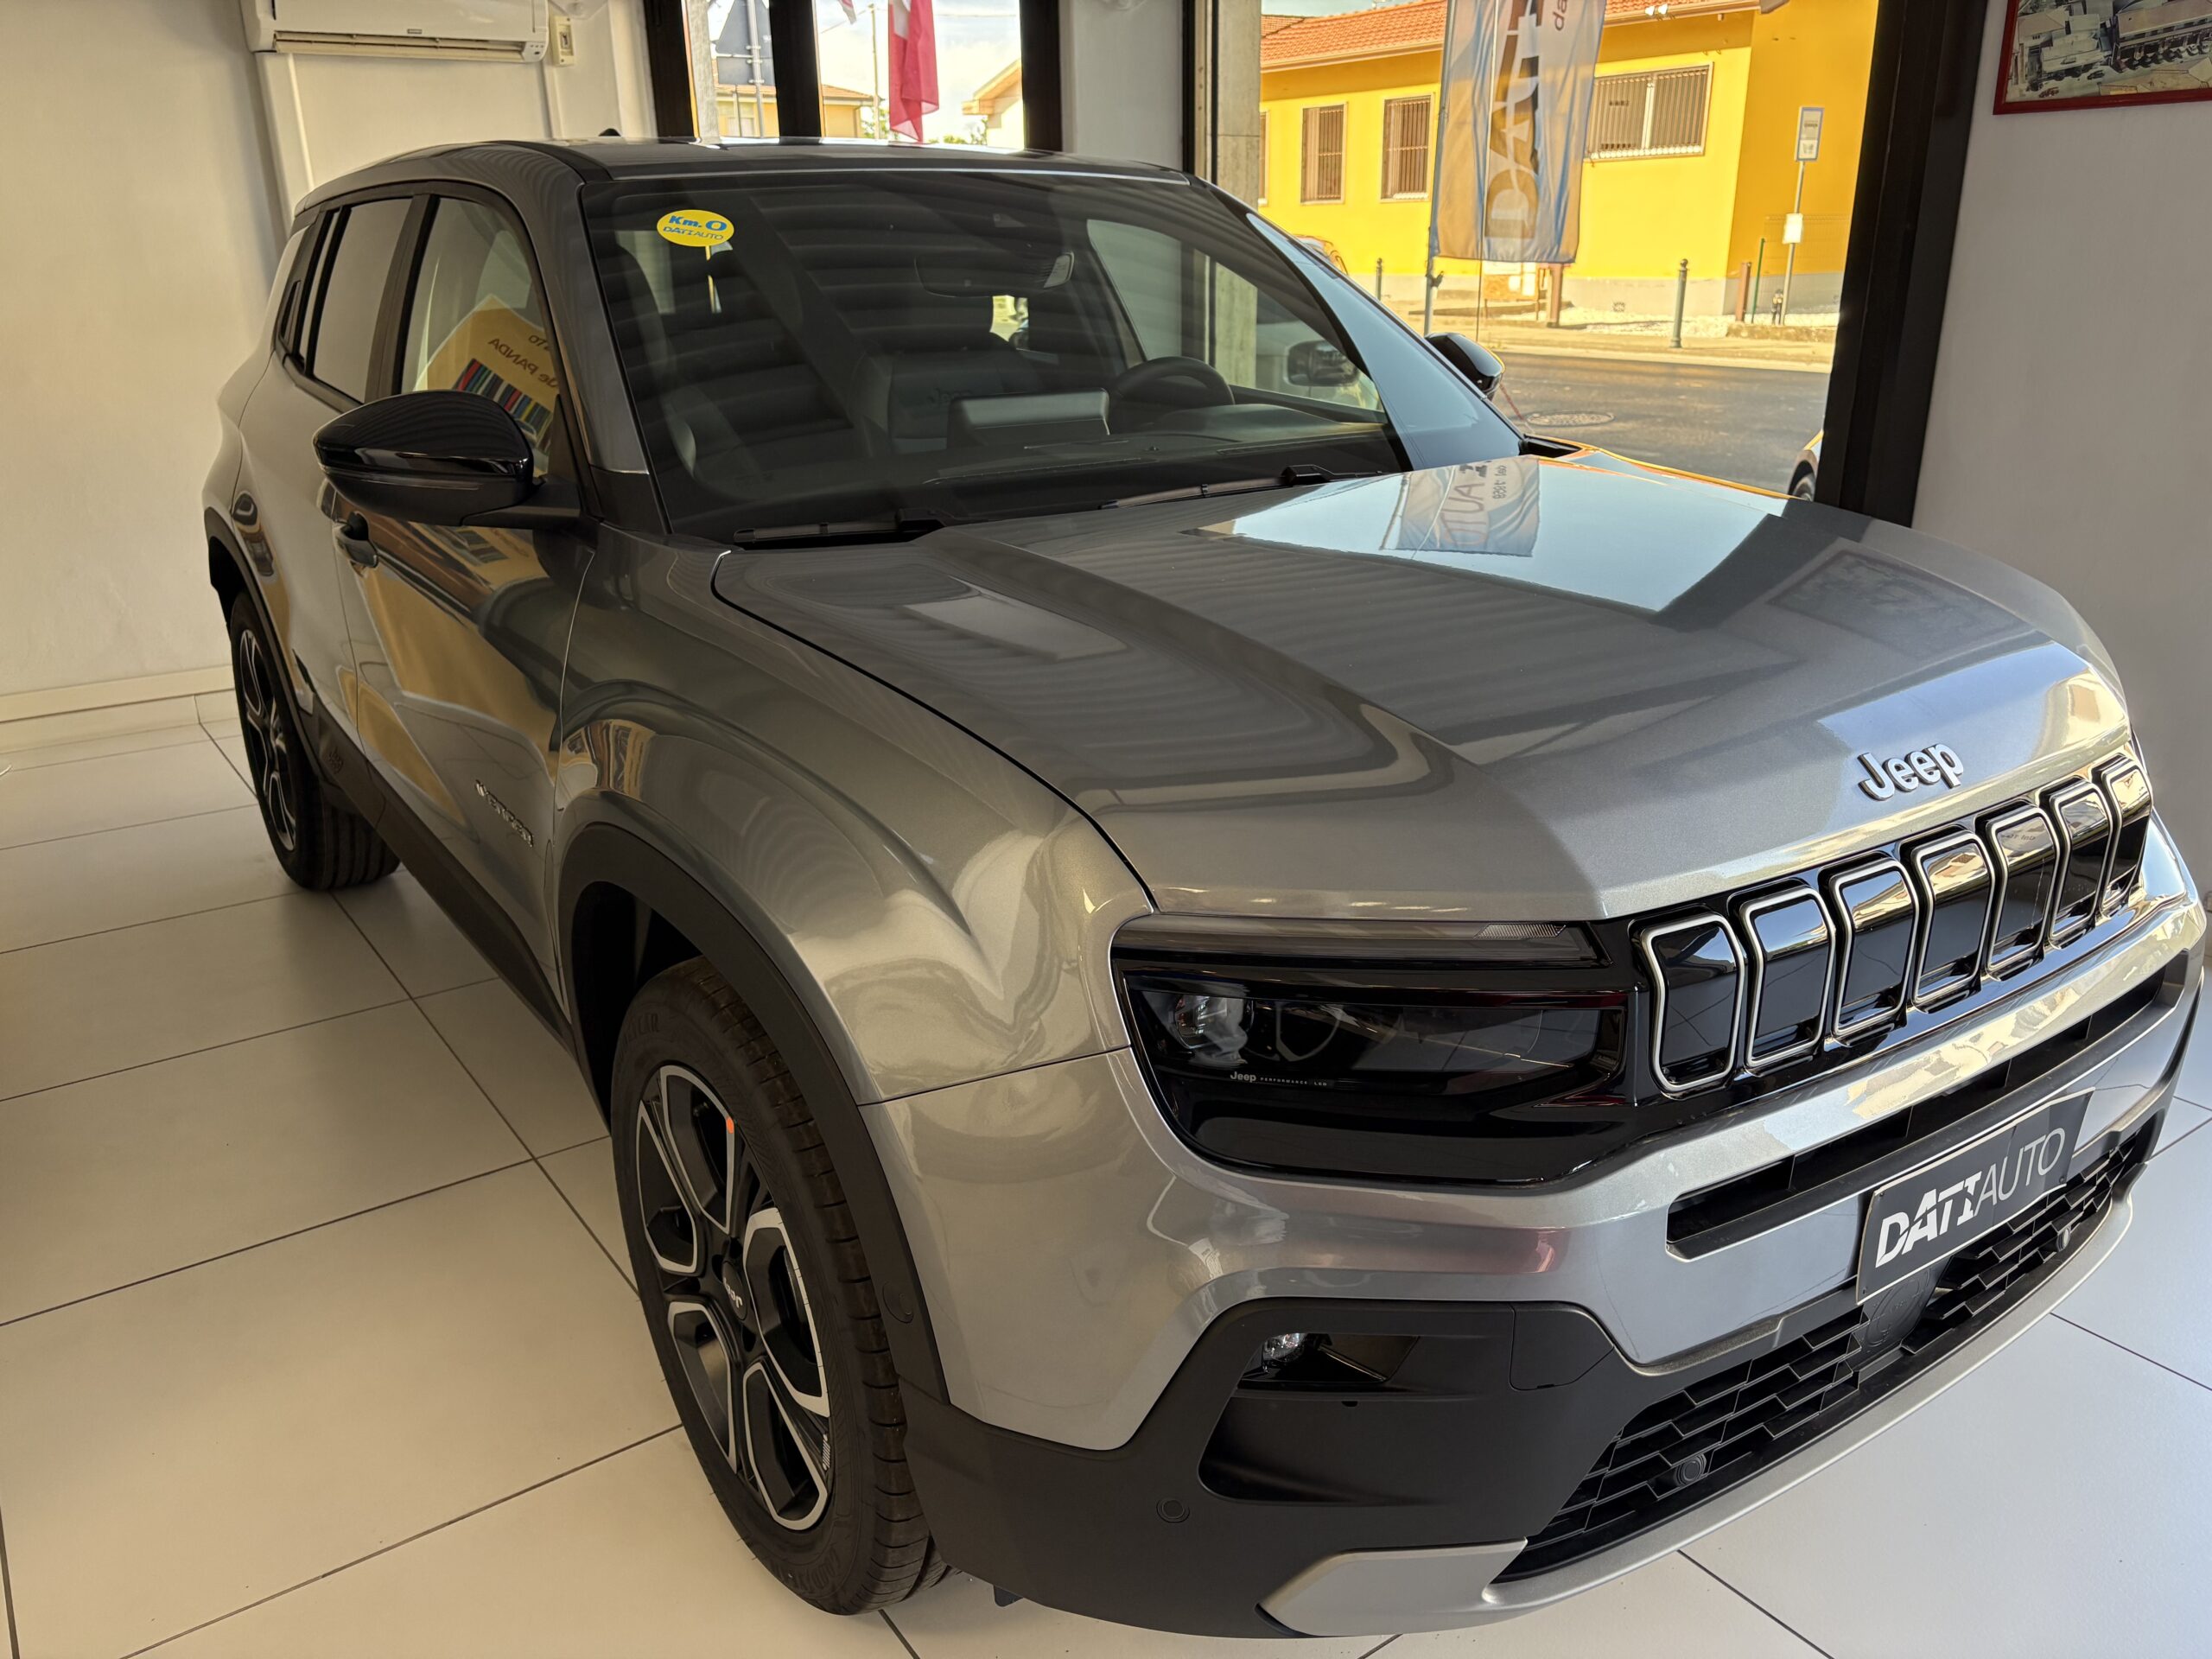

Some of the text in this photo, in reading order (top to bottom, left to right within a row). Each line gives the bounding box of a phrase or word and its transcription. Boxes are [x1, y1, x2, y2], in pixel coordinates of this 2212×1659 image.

[668, 215, 702, 228] Km.
[1857, 743, 1964, 801] Jeep
[1230, 1071, 1257, 1084] Jeep
